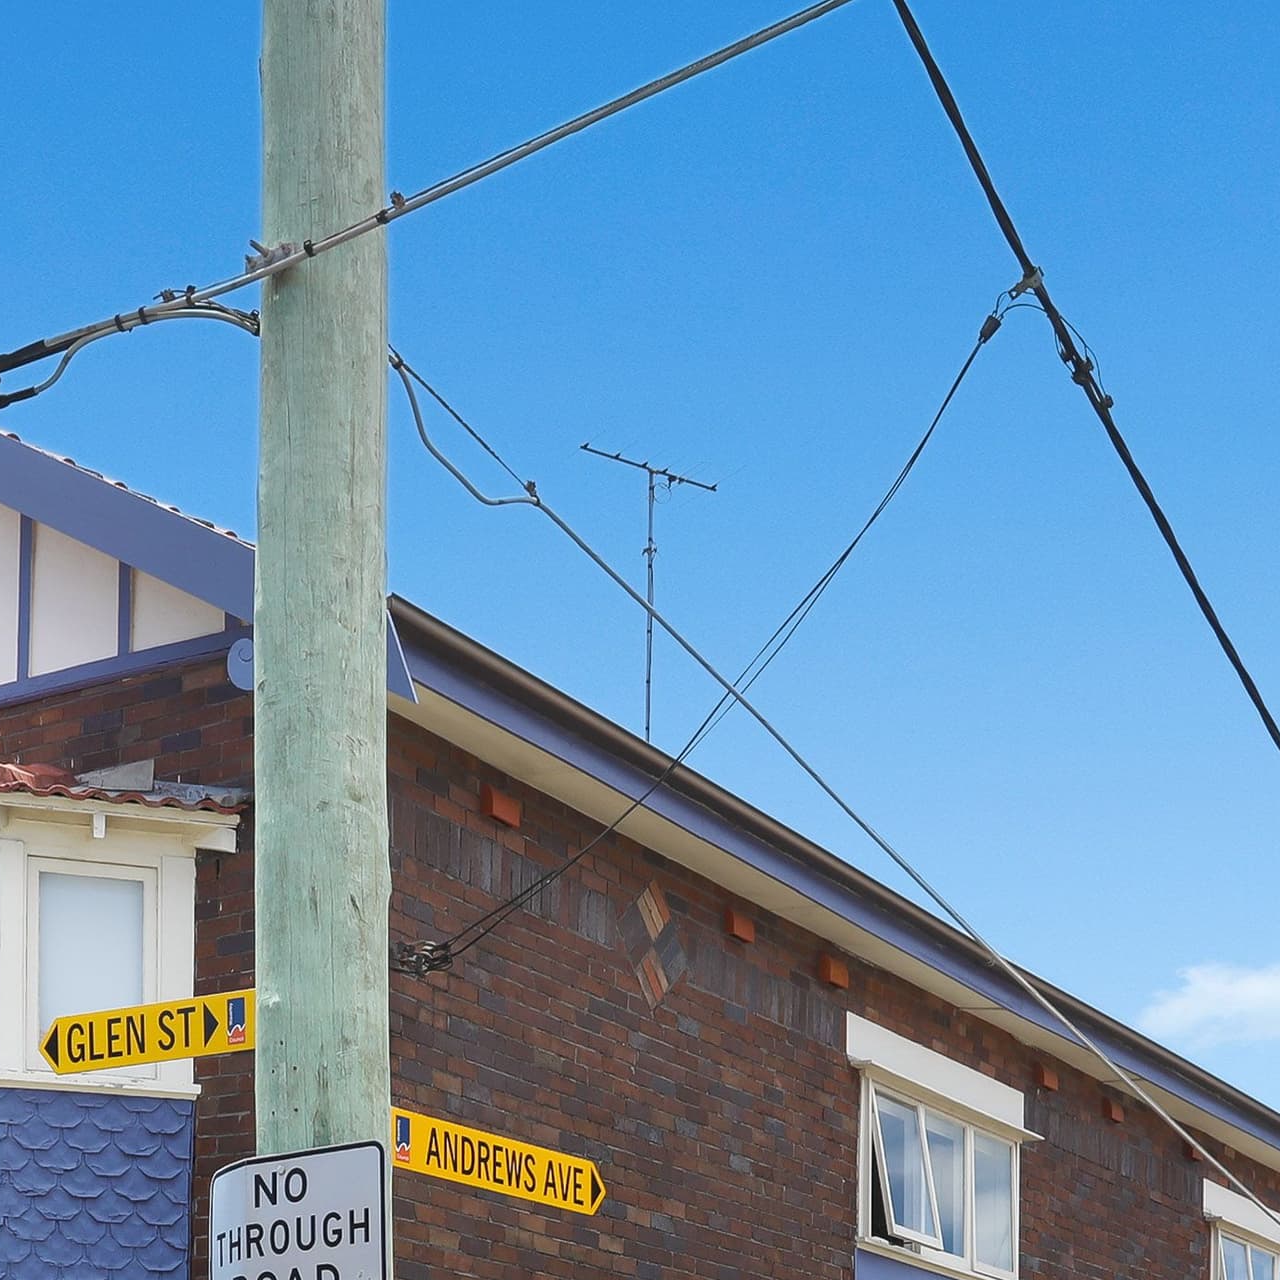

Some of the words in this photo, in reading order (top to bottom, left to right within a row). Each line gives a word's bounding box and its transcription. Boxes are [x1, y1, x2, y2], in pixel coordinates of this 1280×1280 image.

[66, 1014, 146, 1063] GLEN
[157, 1006, 196, 1051] ST
[254, 1167, 308, 1209] NO
[426, 1127, 536, 1193] ANDREWS
[543, 1160, 584, 1206] AVE
[216, 1207, 370, 1268] THROUGH
